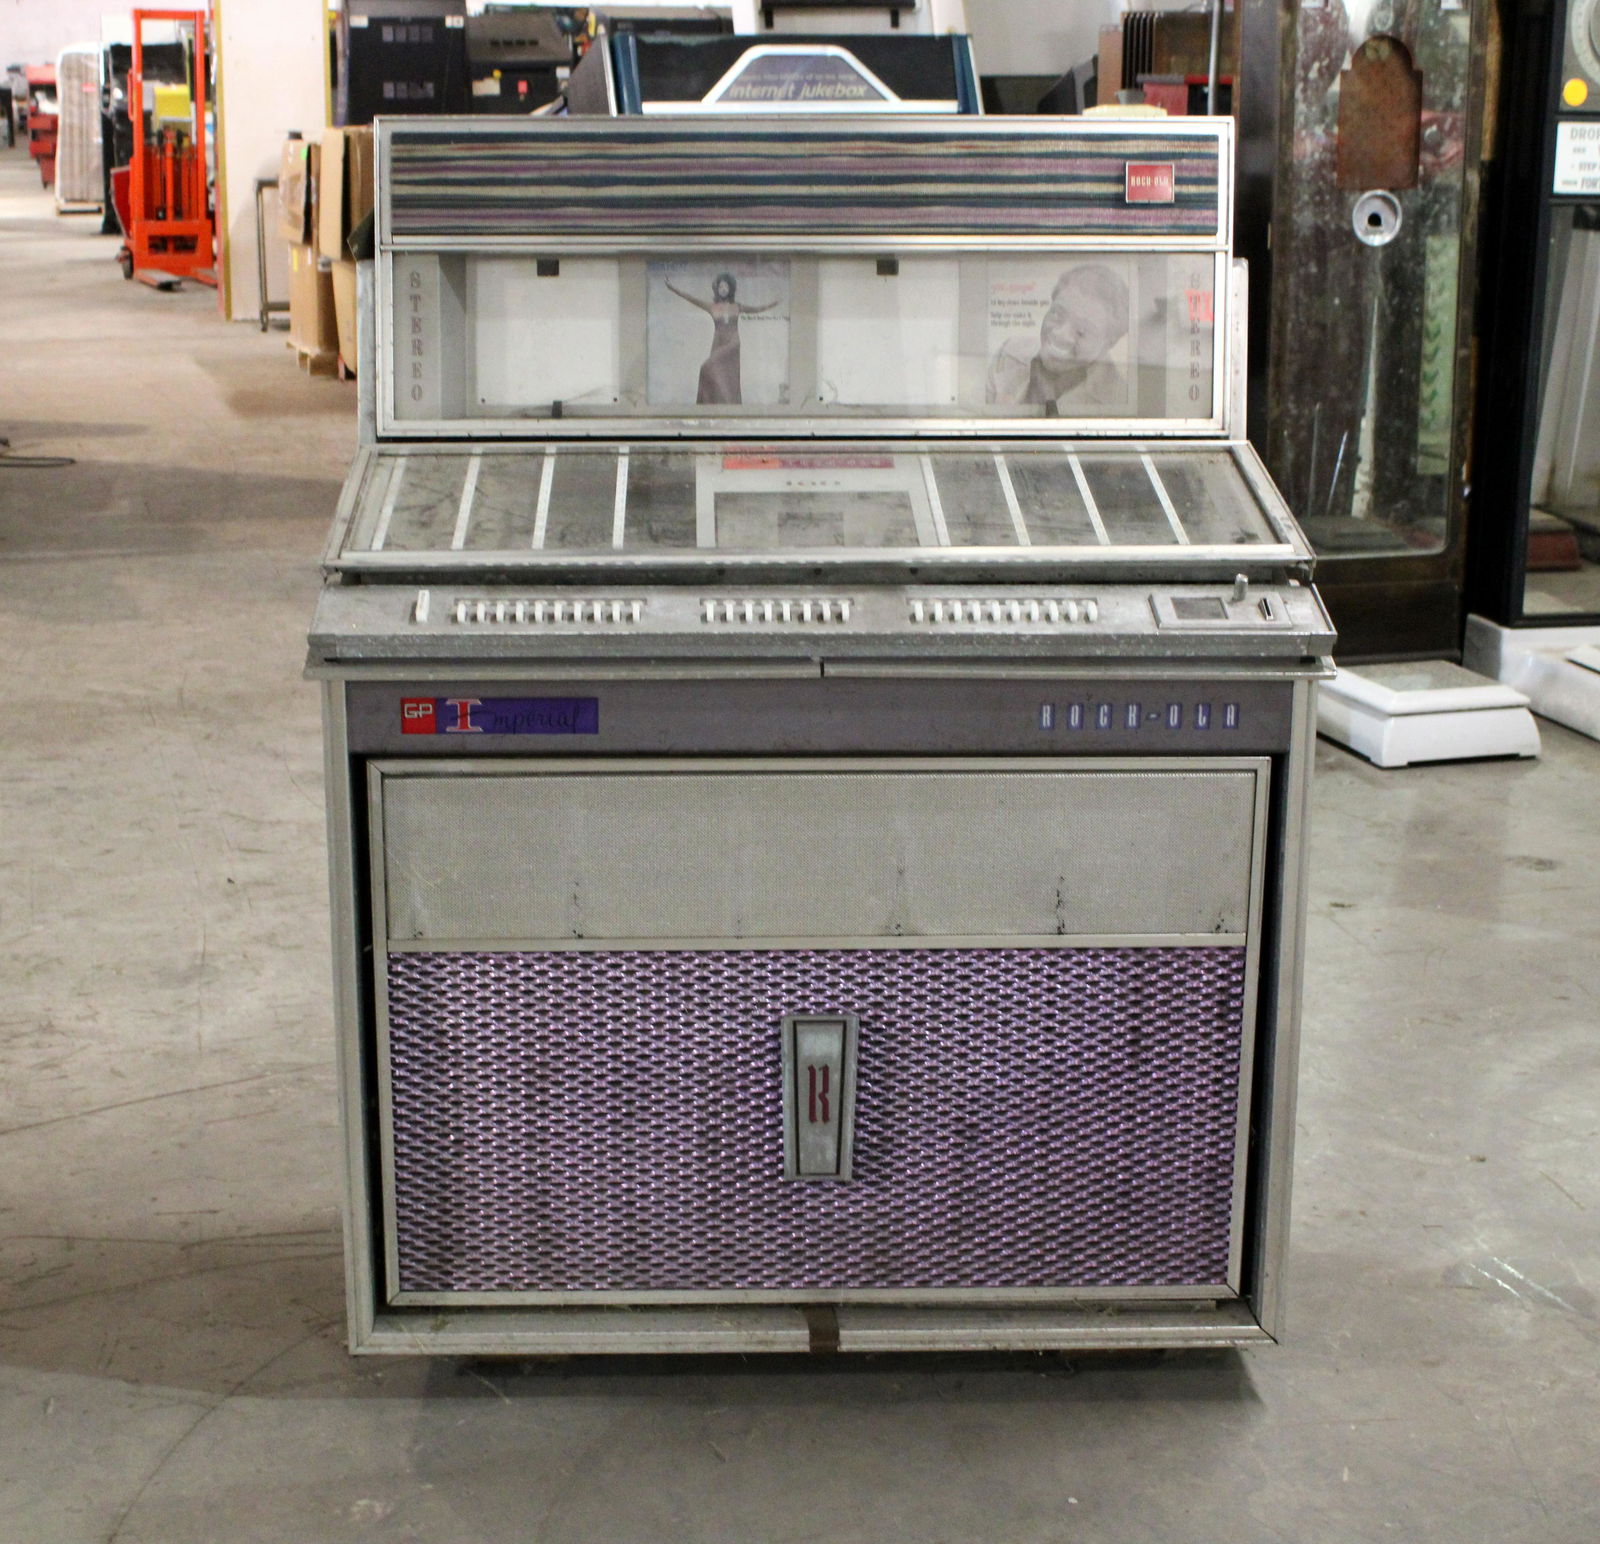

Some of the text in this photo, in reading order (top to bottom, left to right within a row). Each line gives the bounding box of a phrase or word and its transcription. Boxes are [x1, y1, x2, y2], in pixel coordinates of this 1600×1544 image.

[799, 82, 868, 100] jukebox
[409, 271, 423, 401] STEREO
[404, 703, 433, 719] GP
